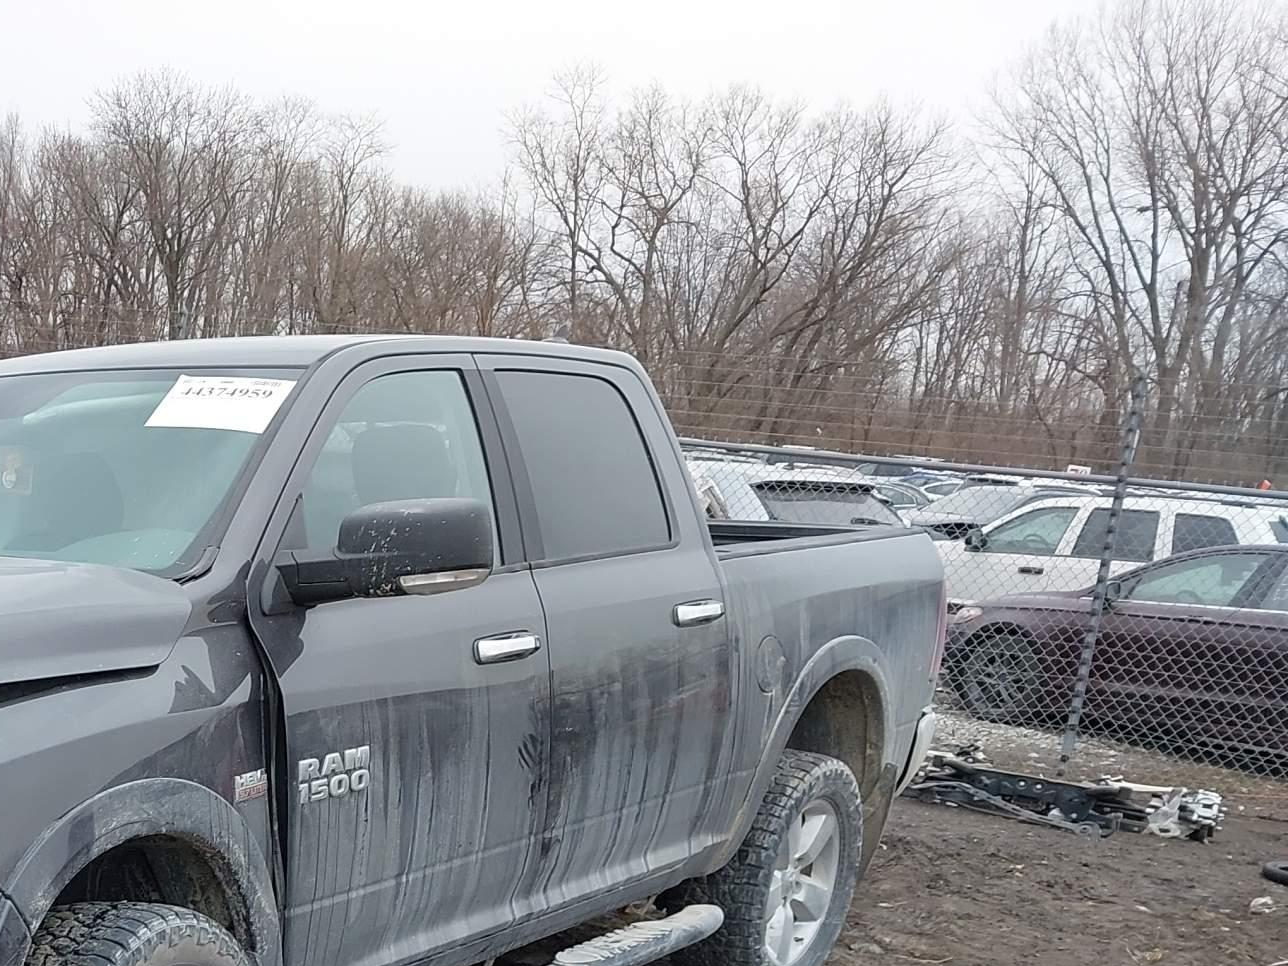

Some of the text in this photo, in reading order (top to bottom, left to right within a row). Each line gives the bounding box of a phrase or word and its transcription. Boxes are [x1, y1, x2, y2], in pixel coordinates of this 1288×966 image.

[181, 387, 273, 398] 44374959
[299, 746, 370, 782] RAM
[298, 769, 370, 804] 1500
